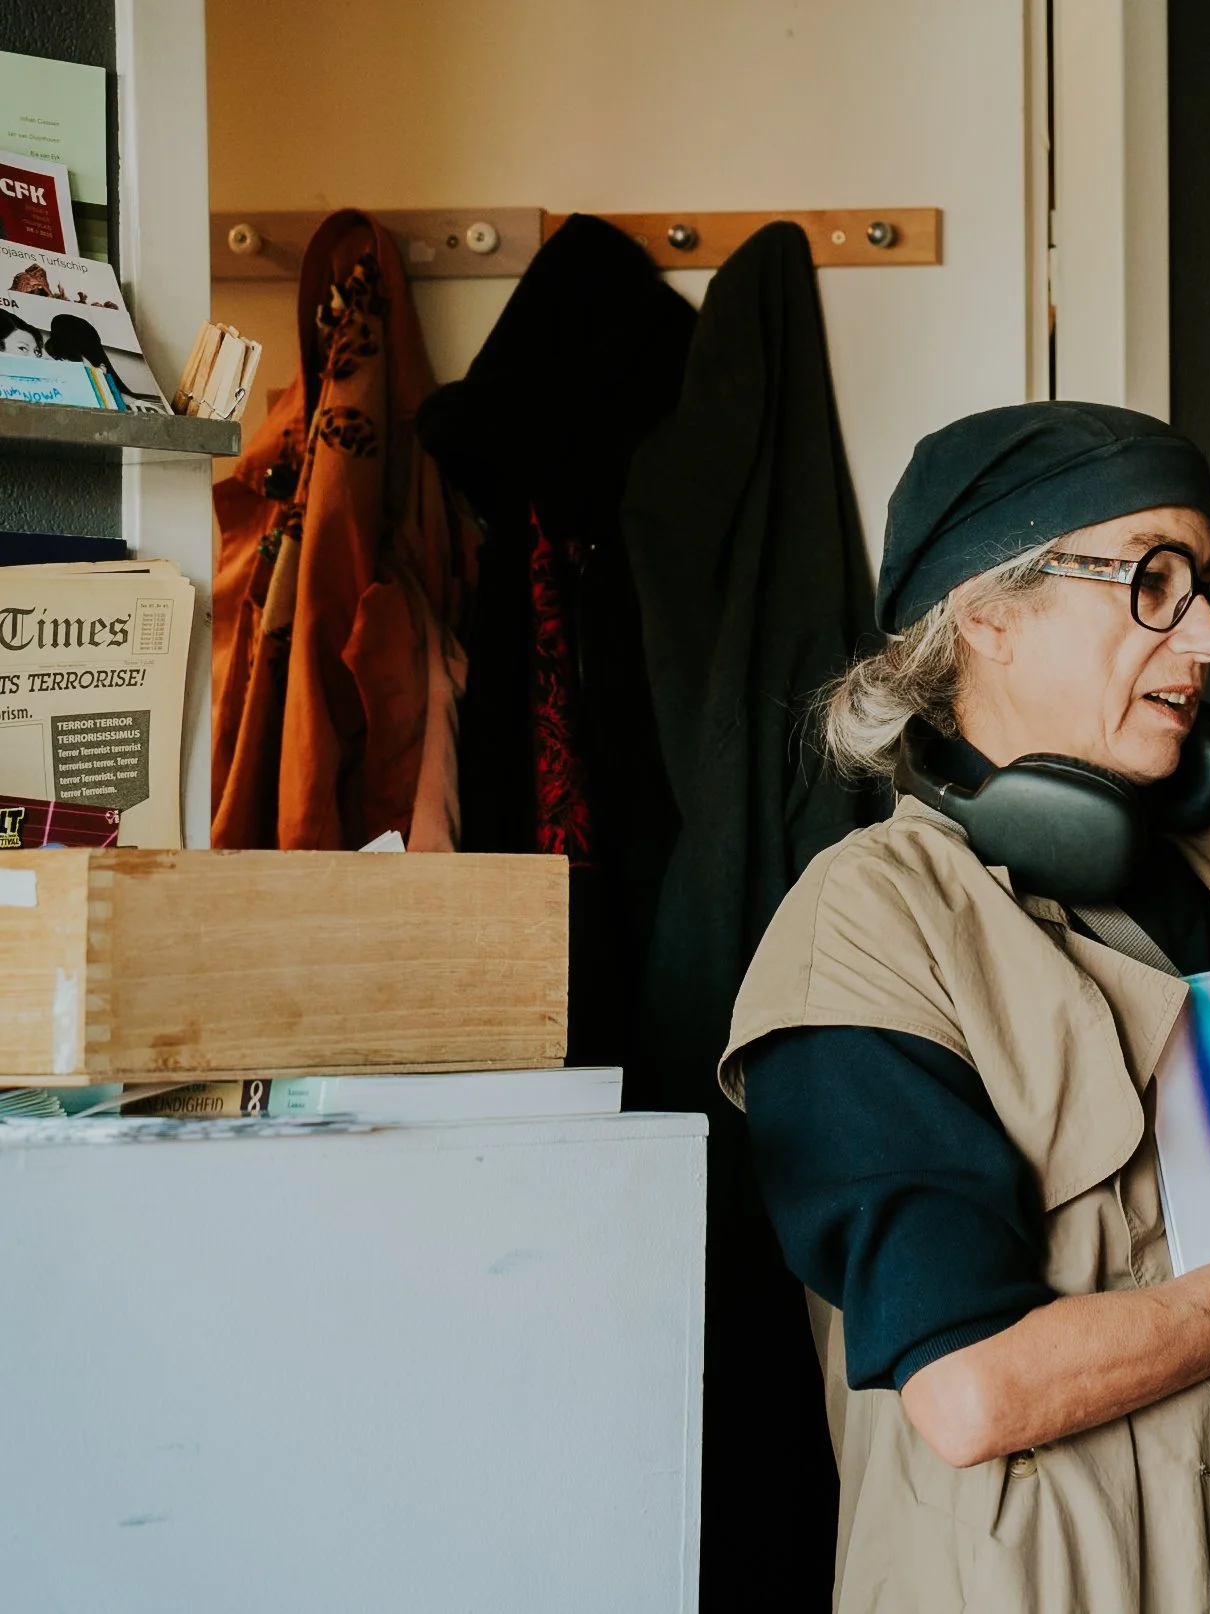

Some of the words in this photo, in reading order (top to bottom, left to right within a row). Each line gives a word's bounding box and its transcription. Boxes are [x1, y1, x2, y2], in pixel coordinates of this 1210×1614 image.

[0, 178, 47, 206] CFK
[0, 246, 37, 262] ojaans
[39, 253, 88, 273] Turfschip
[0, 606, 131, 651] Times
[28, 669, 146, 692] TERRORISE!
[57, 719, 94, 731] TERROR
[95, 717, 133, 728] TERROR
[57, 729, 141, 744] TERRORISISSIMUS
[58, 749, 80, 757] Terror
[80, 745, 110, 756] Terrorist
[111, 743, 142, 753] terrorist
[59, 761, 93, 771] terrorises
[93, 760, 116, 768] terror.
[117, 757, 139, 766] Terror
[60, 776, 81, 785] terror
[81, 772, 117, 783] Terrorists,
[117, 770, 138, 779] terror
[60, 789, 81, 798] terror
[81, 785, 118, 796] Terrorism.
